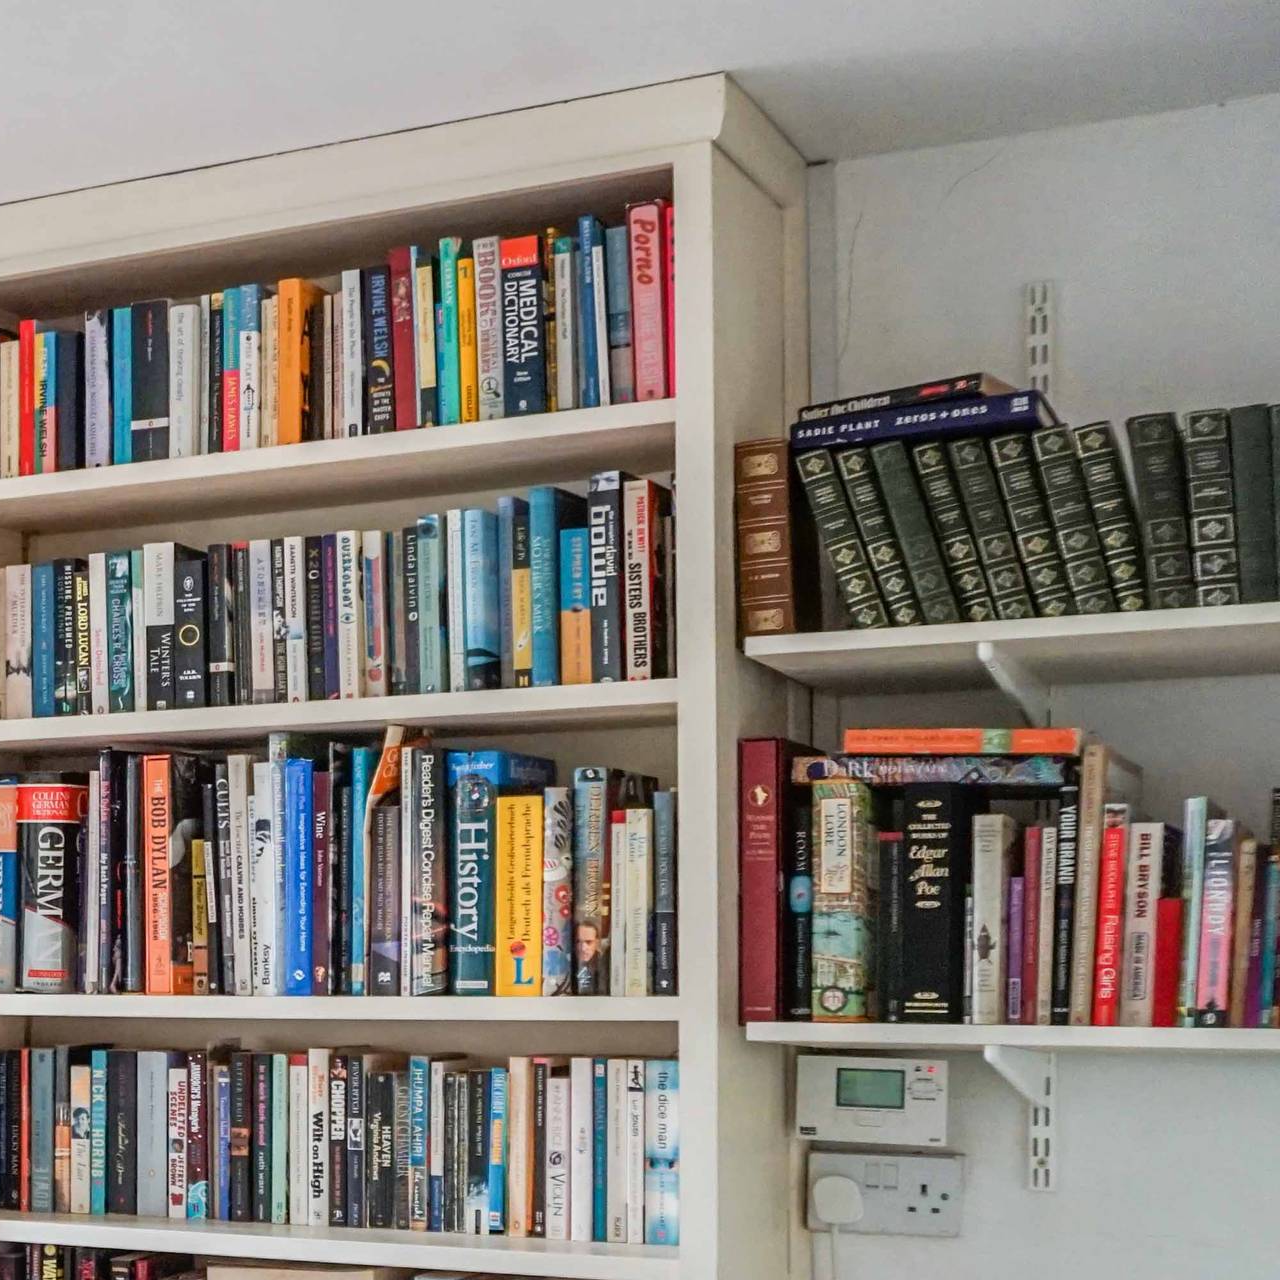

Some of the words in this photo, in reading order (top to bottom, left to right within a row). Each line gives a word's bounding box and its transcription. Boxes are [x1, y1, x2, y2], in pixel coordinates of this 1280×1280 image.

[502, 254, 537, 269] Oxford
[633, 219, 655, 285] Porno
[371, 275, 386, 314] IRVINE
[479, 252, 497, 316] BOOK
[374, 316, 388, 358] WELSH
[504, 282, 519, 363] DICTIONARY
[519, 281, 538, 363] MEDICAL
[39, 380, 47, 416] IRVINE
[39, 419, 47, 457] WELSH
[798, 426, 834, 439] SADIE
[840, 420, 880, 433] PLANT
[895, 412, 935, 426] zeros
[953, 405, 988, 418] ones
[289, 544, 297, 574] JEANETTE
[407, 535, 417, 569] Linda
[591, 505, 610, 606] bowie
[606, 545, 617, 576] david
[290, 577, 298, 618] WINTERSON
[628, 563, 642, 609] SISTERS
[77, 603, 88, 630] LORD
[112, 599, 121, 640] CHARLES
[78, 633, 89, 665] LUCAN
[633, 612, 648, 668] BROTHERS
[112, 655, 123, 685] CROSS
[150, 647, 160, 673] TALE
[161, 633, 171, 687] WINTER'S
[421, 755, 434, 807] Reader's
[151, 797, 166, 828] BOB
[216, 779, 229, 829] CULTS
[1060, 805, 1077, 840] YOUR
[316, 811, 326, 839] Wine
[420, 810, 434, 849] Digest
[825, 814, 834, 846] LORE
[837, 803, 848, 857] LONDON
[151, 835, 166, 889] DYLAN
[909, 845, 949, 862] Edgar
[1058, 842, 1076, 885] BRAND
[1139, 833, 1151, 861] BILL
[299, 871, 307, 881] for
[422, 851, 434, 900] Concise
[450, 819, 489, 941] History
[916, 880, 940, 895] Poe
[1135, 864, 1150, 918] BRYSON
[38, 827, 65, 965] GERMAN
[421, 902, 434, 942] Repair
[1099, 914, 1117, 965] Raising
[262, 945, 272, 985] Banksy
[422, 943, 434, 987] Manual
[513, 958, 534, 985] L
[1098, 967, 1116, 999] Girls
[412, 1067, 424, 1113] JHUMPA
[658, 1072, 668, 1090] the
[331, 1080, 344, 1140] CHOPPER
[658, 1094, 668, 1119] dice
[312, 1111, 323, 1142] Wilt
[370, 1112, 381, 1143] Virginia
[412, 1119, 424, 1157] LAHIRI
[658, 1123, 666, 1149] man
[382, 1126, 391, 1167] HEAVEN
[311, 1162, 323, 1199] High
